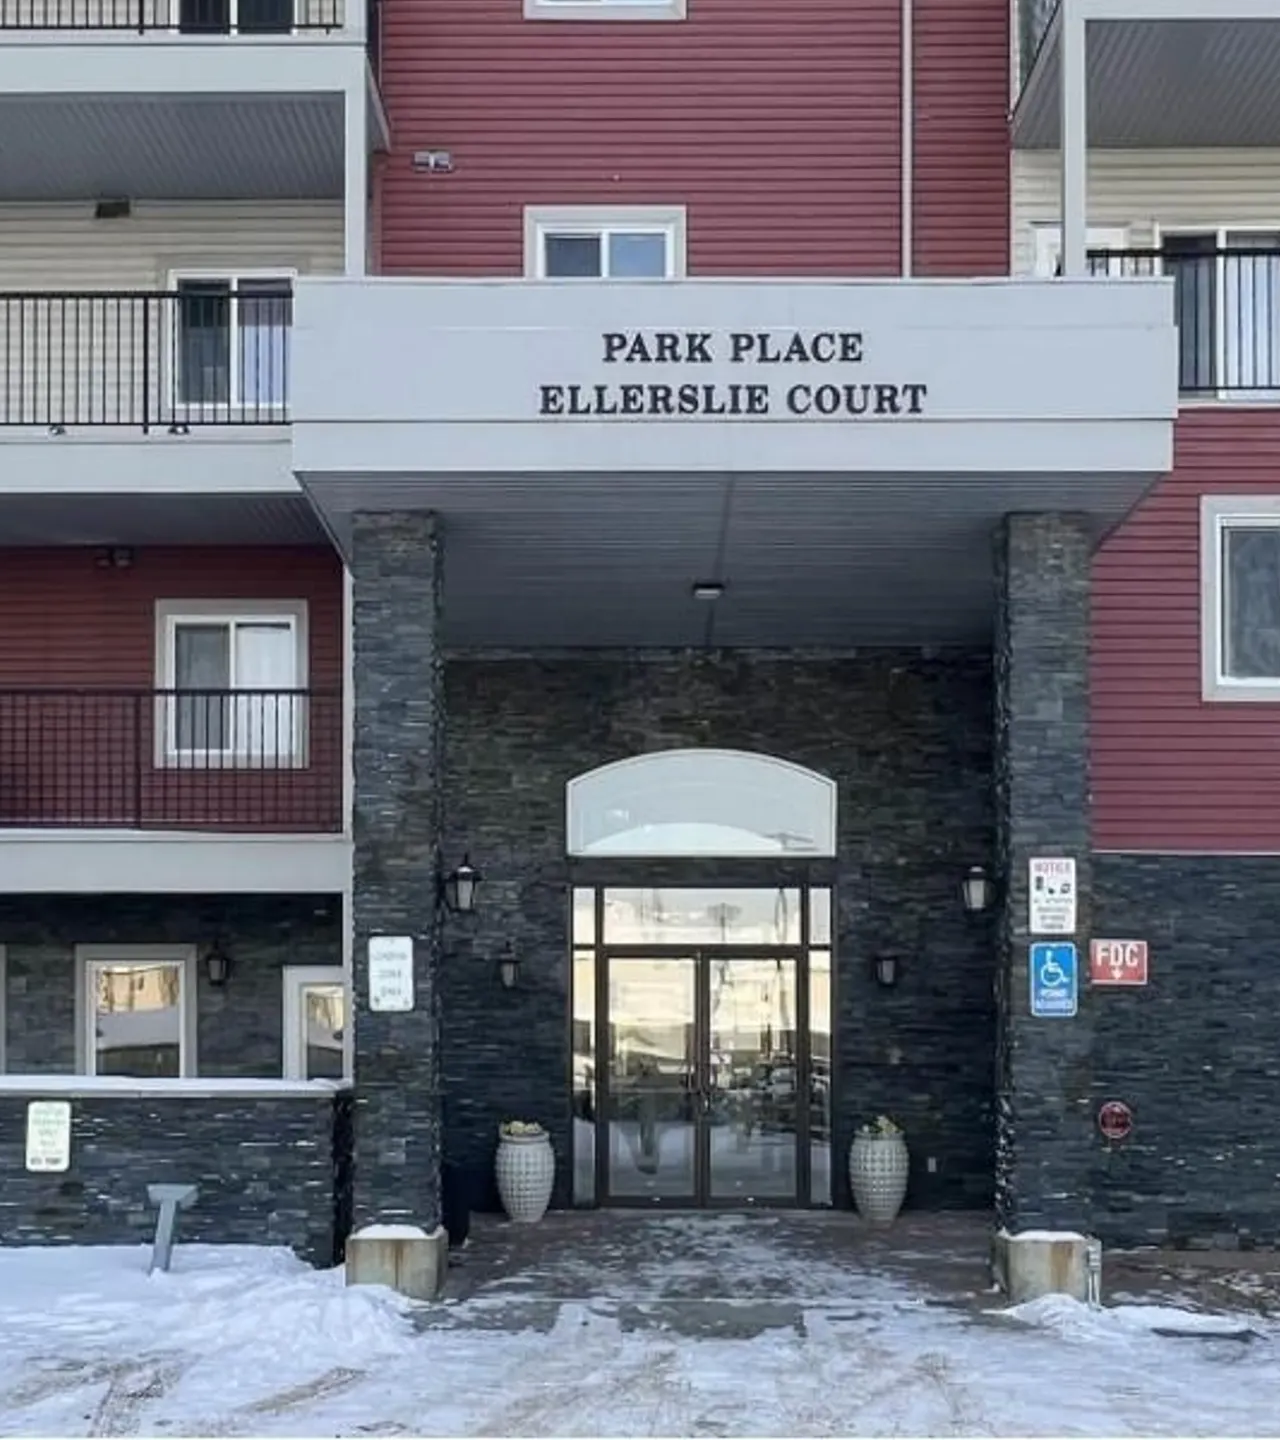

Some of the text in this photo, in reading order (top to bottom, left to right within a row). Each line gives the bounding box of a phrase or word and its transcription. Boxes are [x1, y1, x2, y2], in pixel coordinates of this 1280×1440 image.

[602, 333, 864, 364] PARK PLACE
[539, 384, 928, 416] ELLERSLIE COURT
[1096, 942, 1140, 967] FDC
